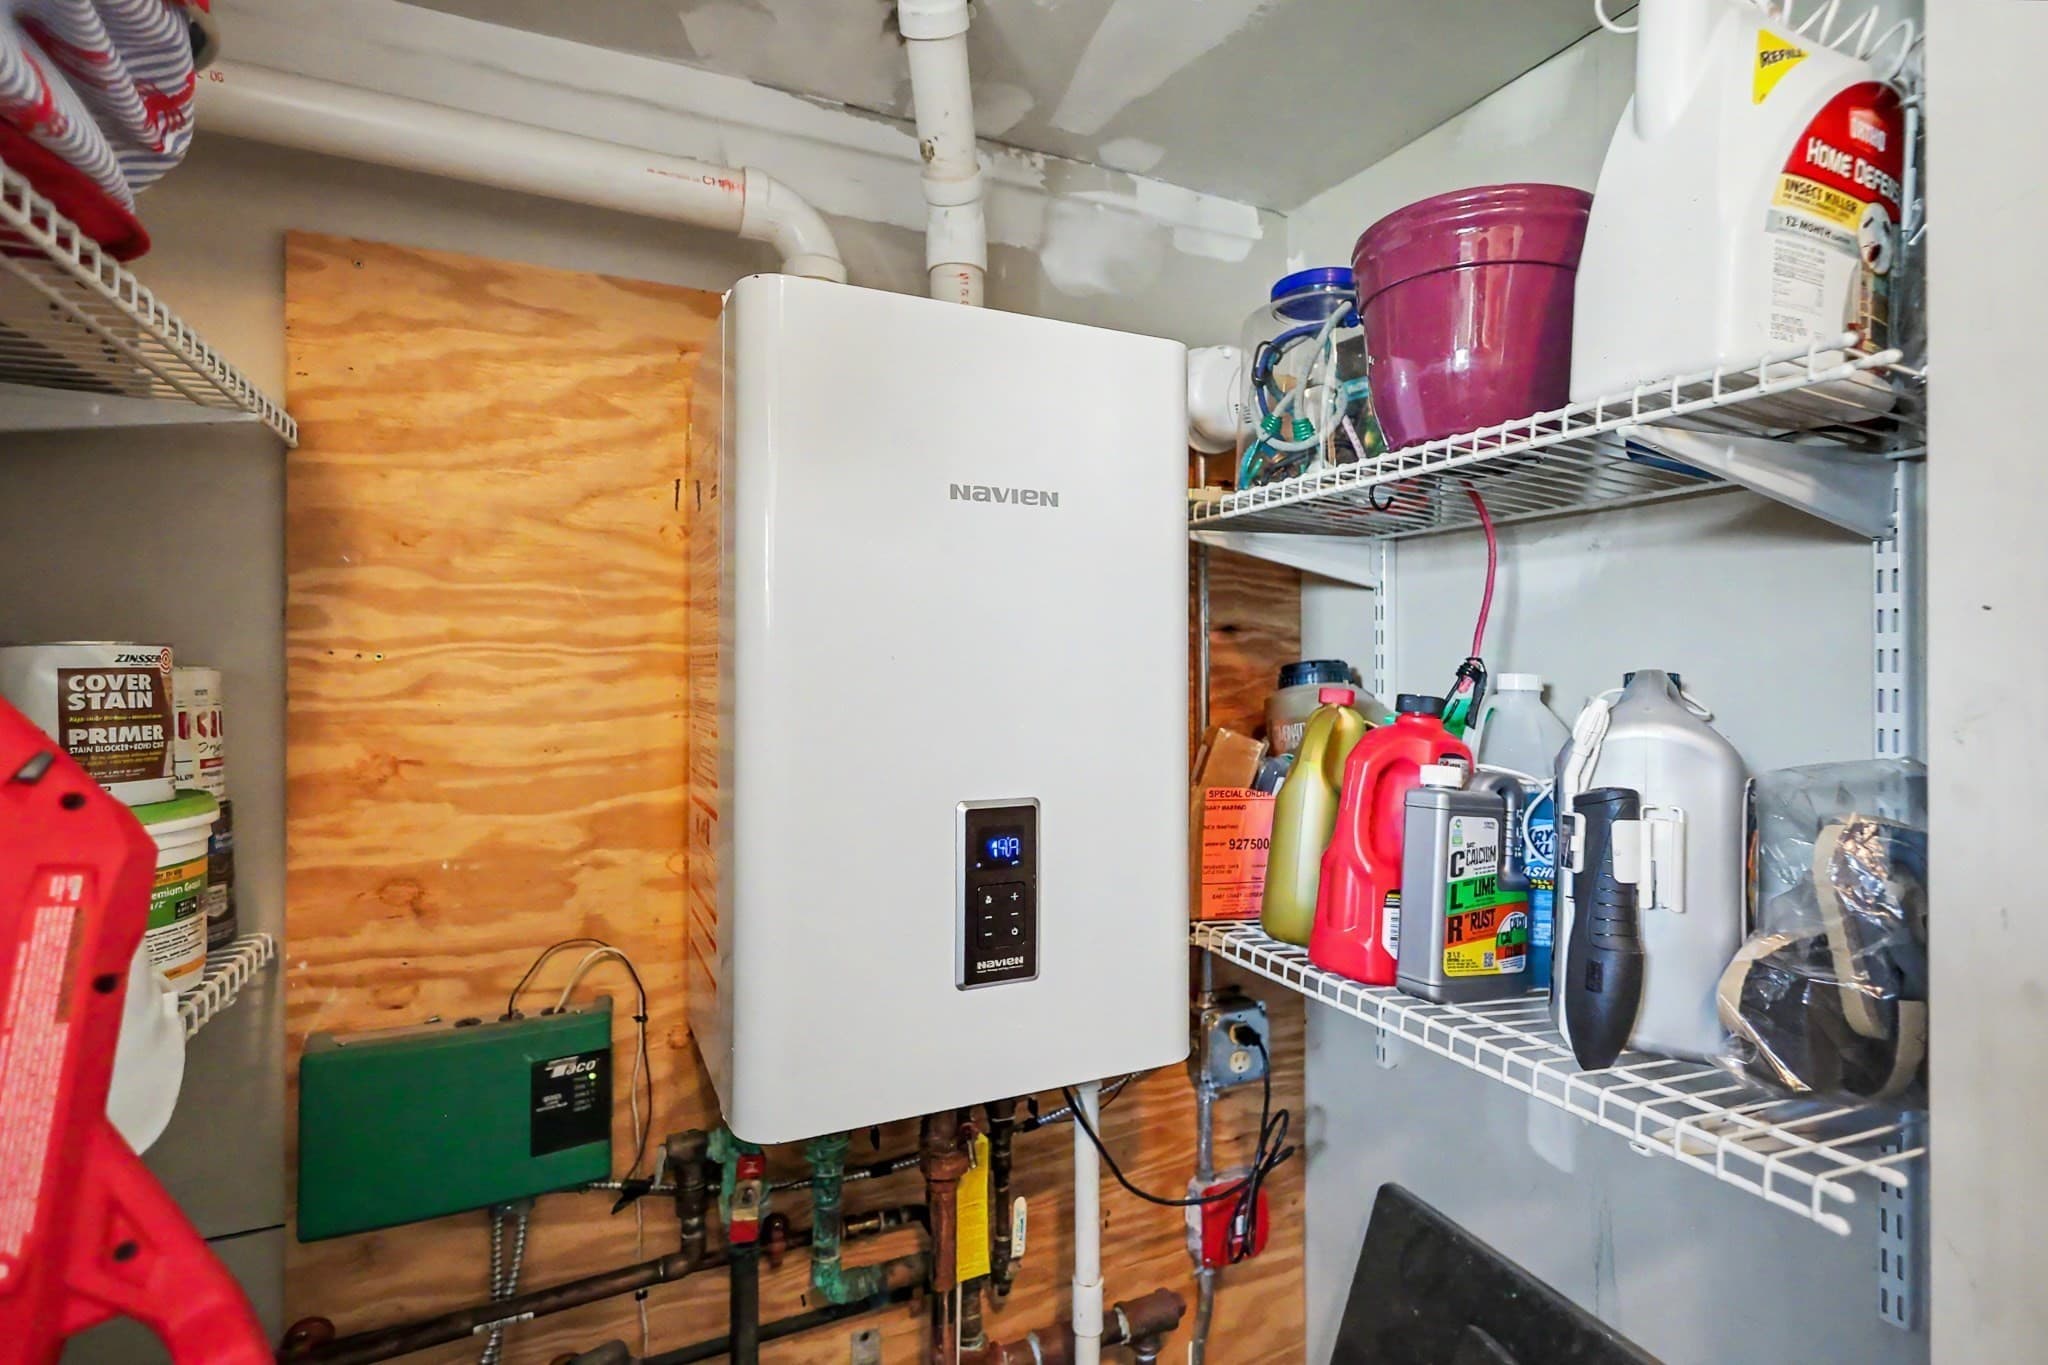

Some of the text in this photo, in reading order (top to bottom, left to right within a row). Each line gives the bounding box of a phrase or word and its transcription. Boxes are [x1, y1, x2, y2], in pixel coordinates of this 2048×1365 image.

[1806, 136, 1854, 179] HOME
[1784, 178, 1823, 202] INSECT
[1824, 189, 1858, 214] KILLER
[1799, 220, 1832, 238] MONTH
[68, 673, 152, 692] COVER
[68, 691, 153, 711] STAIN
[68, 725, 164, 745] PRIMER
[70, 744, 94, 755] STAIN
[95, 742, 129, 753] BLOCKER
[1208, 790, 1243, 799] SPECIAL
[1228, 838, 1270, 850] 927500
[1451, 850, 1465, 878] C
[1466, 845, 1497, 867] CALCIUM
[1451, 884, 1463, 910] L
[1473, 877, 1496, 898] LIME
[1448, 916, 1463, 944] R
[1470, 909, 1496, 932] RUST
